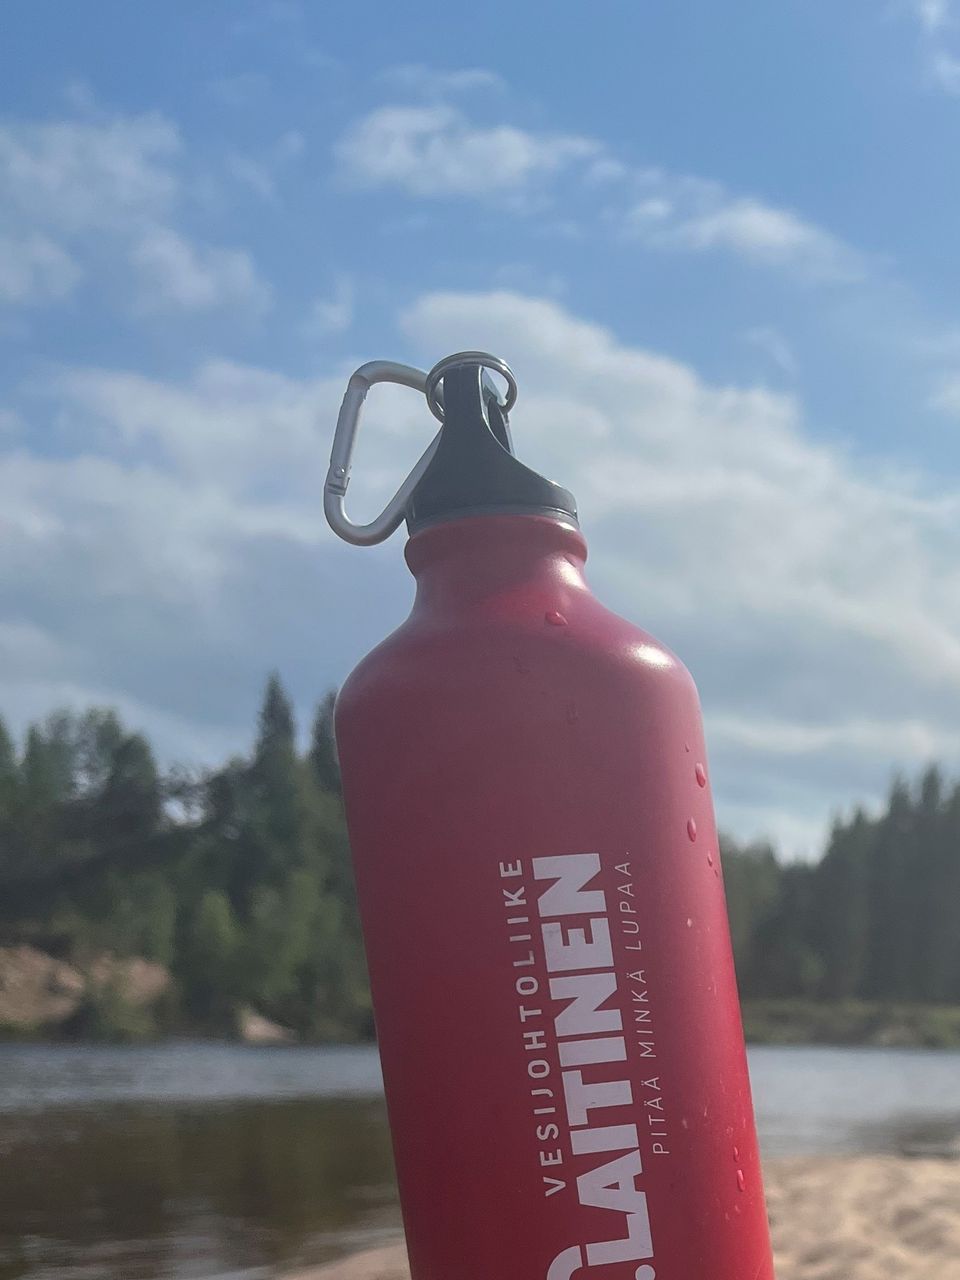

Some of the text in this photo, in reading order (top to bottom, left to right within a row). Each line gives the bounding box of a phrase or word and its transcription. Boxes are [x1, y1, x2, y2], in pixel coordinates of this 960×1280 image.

[499, 858, 567, 1197] VESIJOHTOLIIKE
[614, 850, 669, 1155] PITÄÄ MINKÄ LUPAA.
